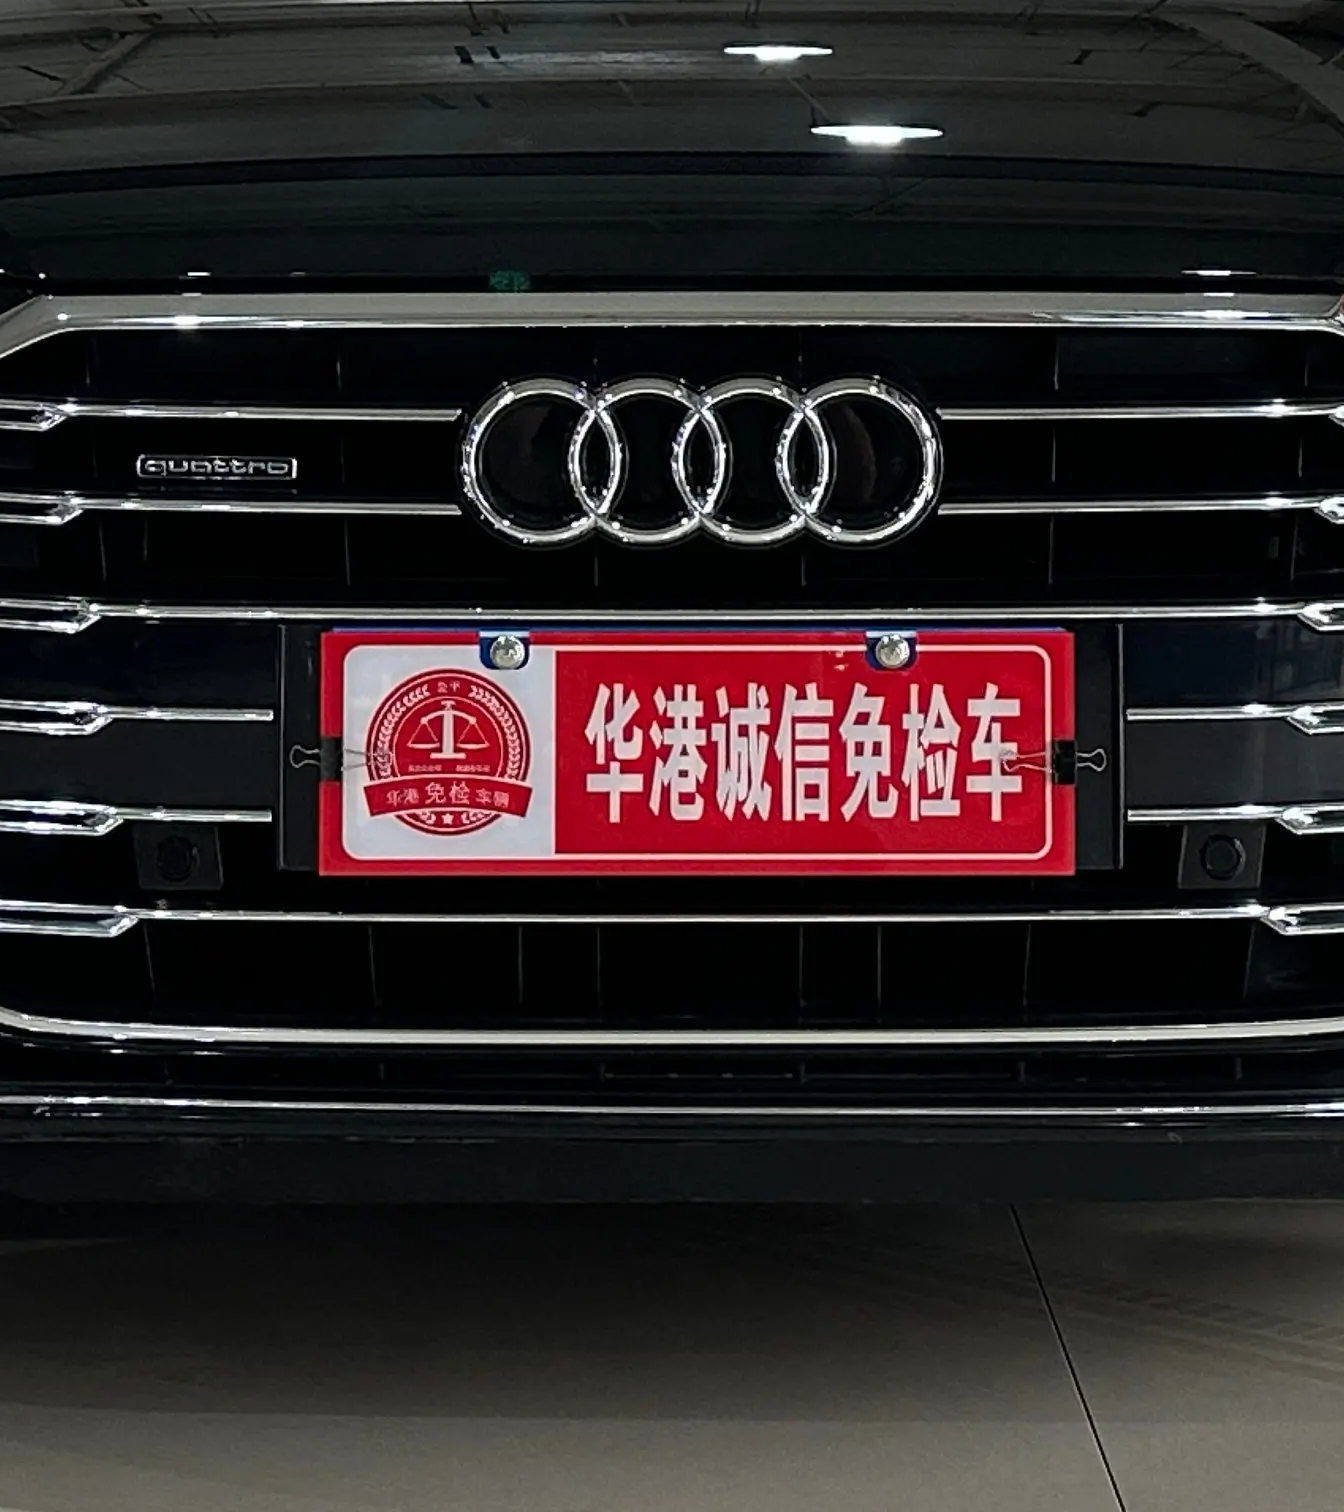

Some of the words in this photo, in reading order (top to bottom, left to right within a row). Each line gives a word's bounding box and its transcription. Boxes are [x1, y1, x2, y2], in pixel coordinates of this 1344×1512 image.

[143, 456, 290, 477] quattro
[584, 682, 1025, 824] 华港诚信免检车
